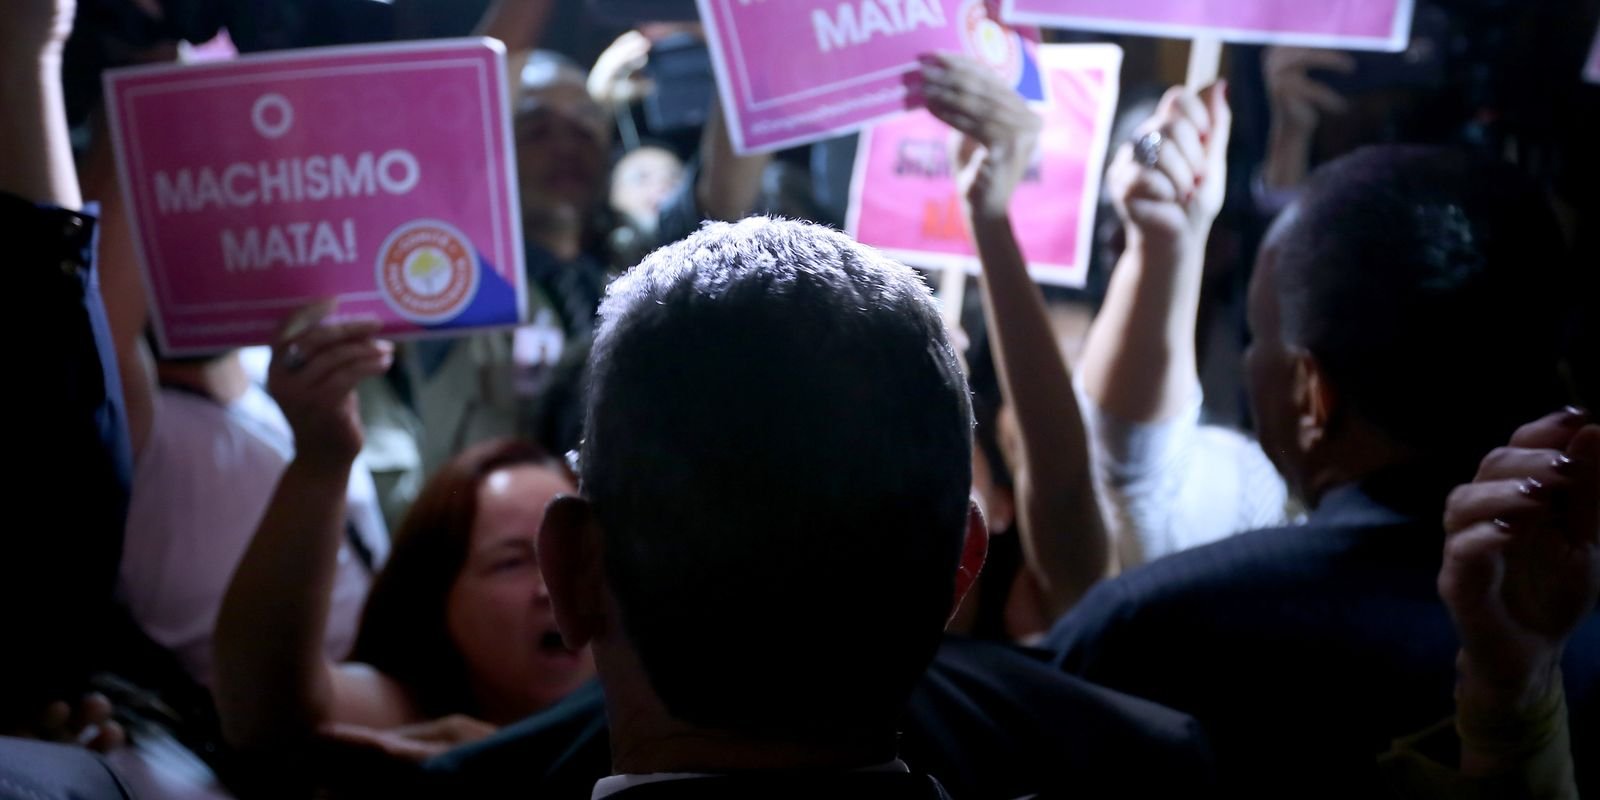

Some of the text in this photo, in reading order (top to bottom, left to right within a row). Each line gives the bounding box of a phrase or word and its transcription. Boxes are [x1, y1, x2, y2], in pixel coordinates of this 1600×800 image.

[252, 93, 293, 138] O
[154, 149, 420, 214] MACHISMO
[220, 217, 358, 272] MATA!
